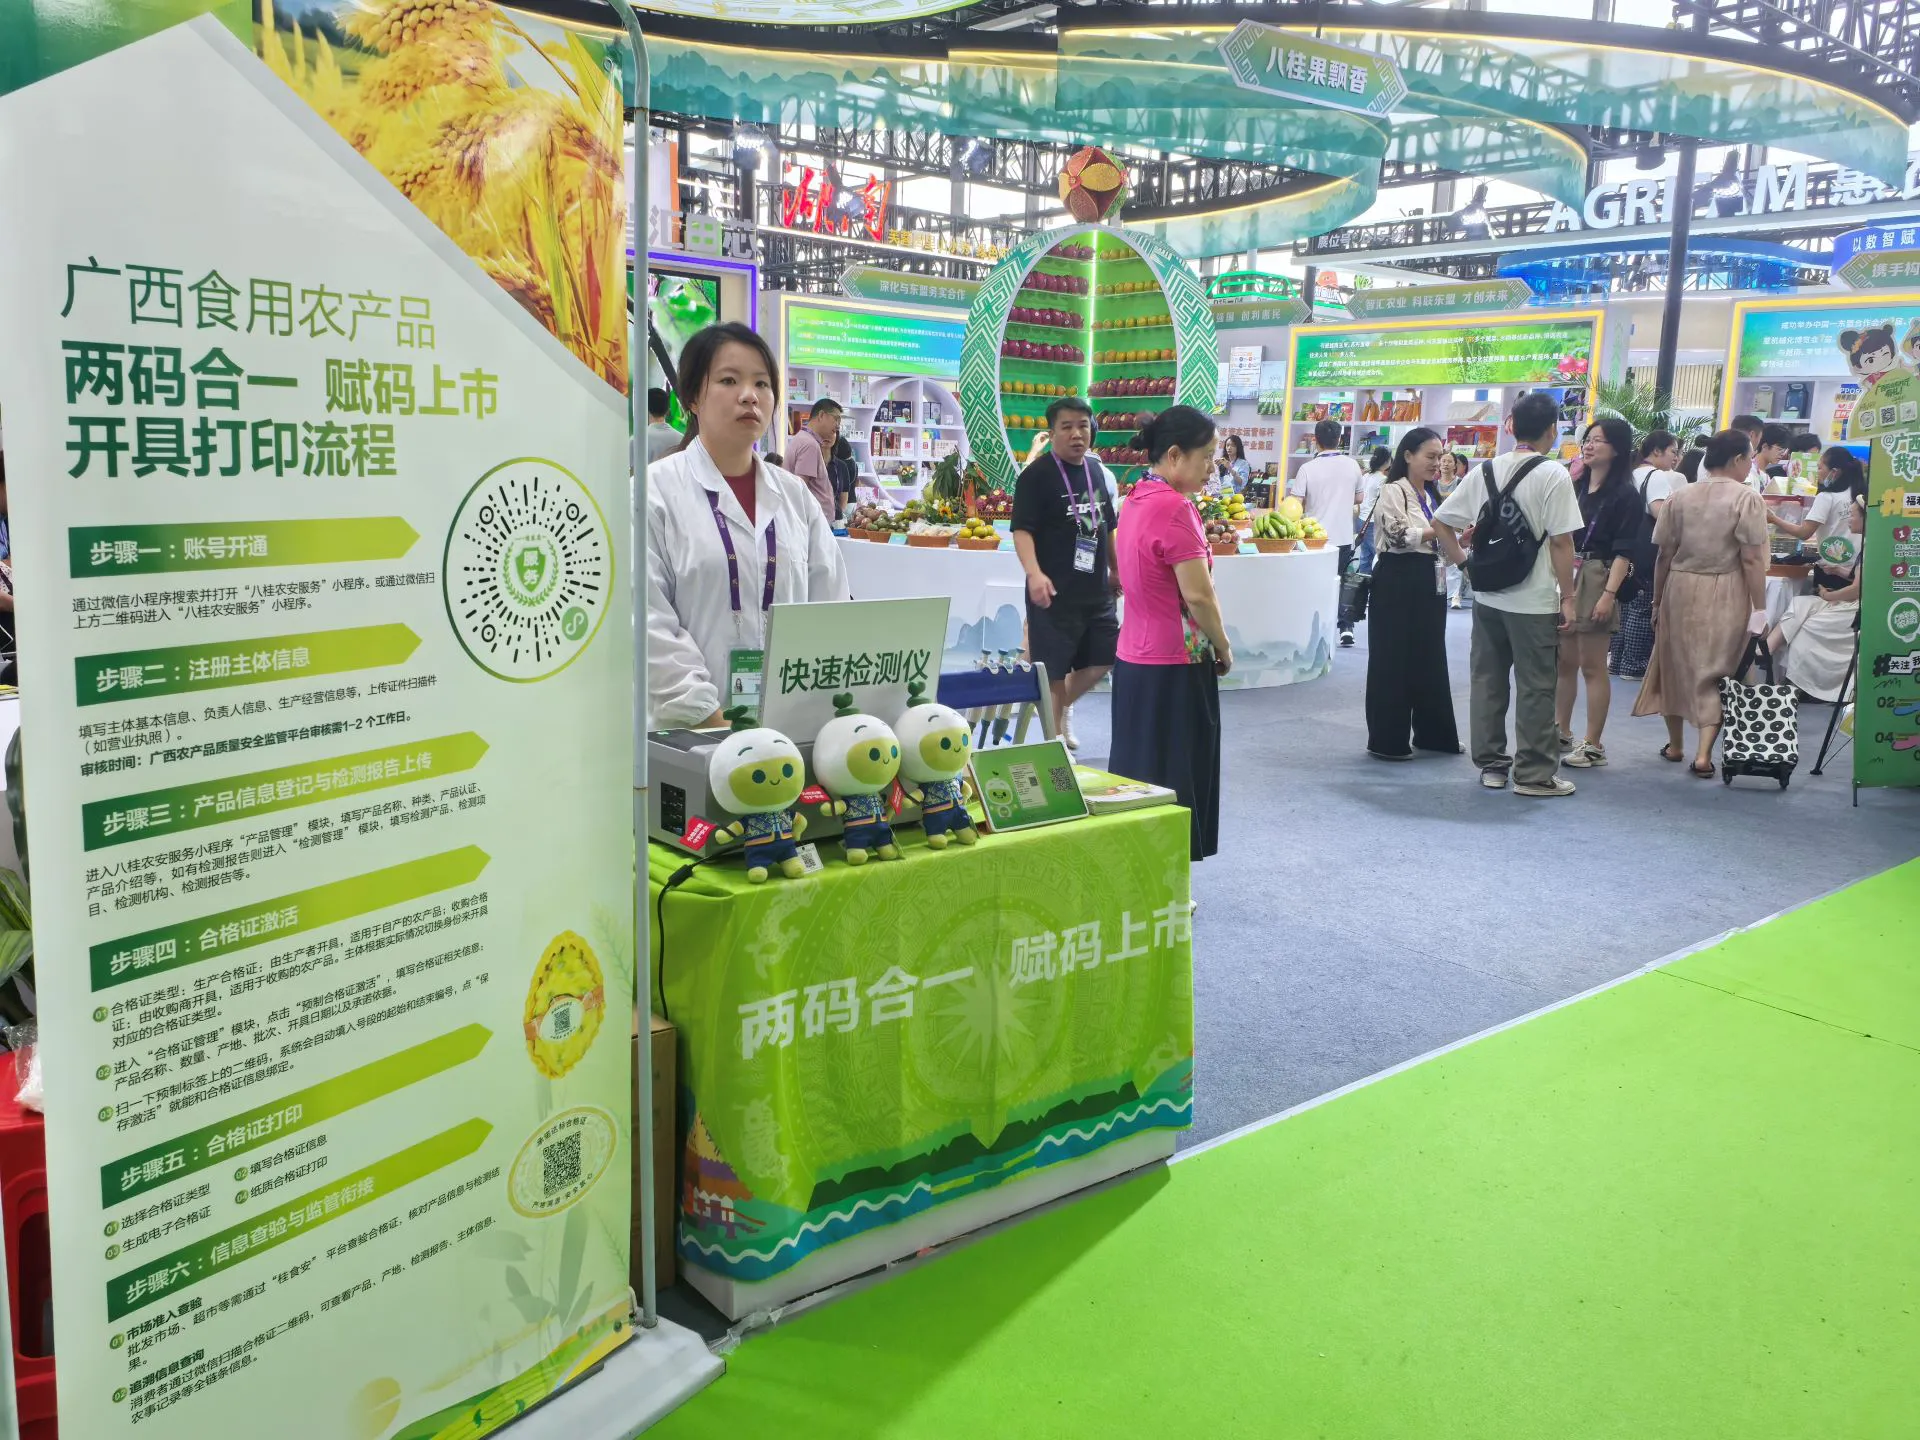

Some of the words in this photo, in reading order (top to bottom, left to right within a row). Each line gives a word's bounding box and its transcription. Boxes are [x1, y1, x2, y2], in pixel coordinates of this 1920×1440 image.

[1266, 46, 1368, 95] 八桂果飘香
[1853, 228, 1916, 252] 以数智赋
[60, 256, 435, 350] 广西食用农产品
[880, 280, 965, 301] 深化与东盟务实合作
[1463, 290, 1508, 304] 才创未来
[61, 339, 299, 410] 两码合一
[325, 357, 499, 420] 赋码上市
[65, 415, 397, 479] 开具打印流程
[90, 535, 268, 566] 步骤一：账号开通
[96, 647, 310, 692] 步骤二：注册主体信息
[779, 648, 929, 696] 快速检测仪
[1877, 697, 1895, 708] 02
[1875, 732, 1894, 743] 04
[103, 752, 433, 837] 步骤三：产品信息登记与检测报告上传
[110, 905, 299, 976] 步骤四：合格证激活
[738, 965, 974, 1060] 两码合一
[1009, 900, 1192, 988] 赋码上市
[112, 1006, 223, 1049] 对应的合格证类型。
[120, 1103, 303, 1191] 步骤五：合格证打印
[250, 1134, 327, 1175] 填写合格证信息
[251, 1156, 328, 1199] 纸质合格证打印
[121, 1183, 211, 1230] 选择合格证类型
[122, 1205, 211, 1253] 生成电子合格证
[126, 1176, 375, 1304] 步骤六：信息查验与监管衔接
[126, 1297, 202, 1340] 市场准入查验
[129, 1349, 205, 1395] 追溯信息查询
